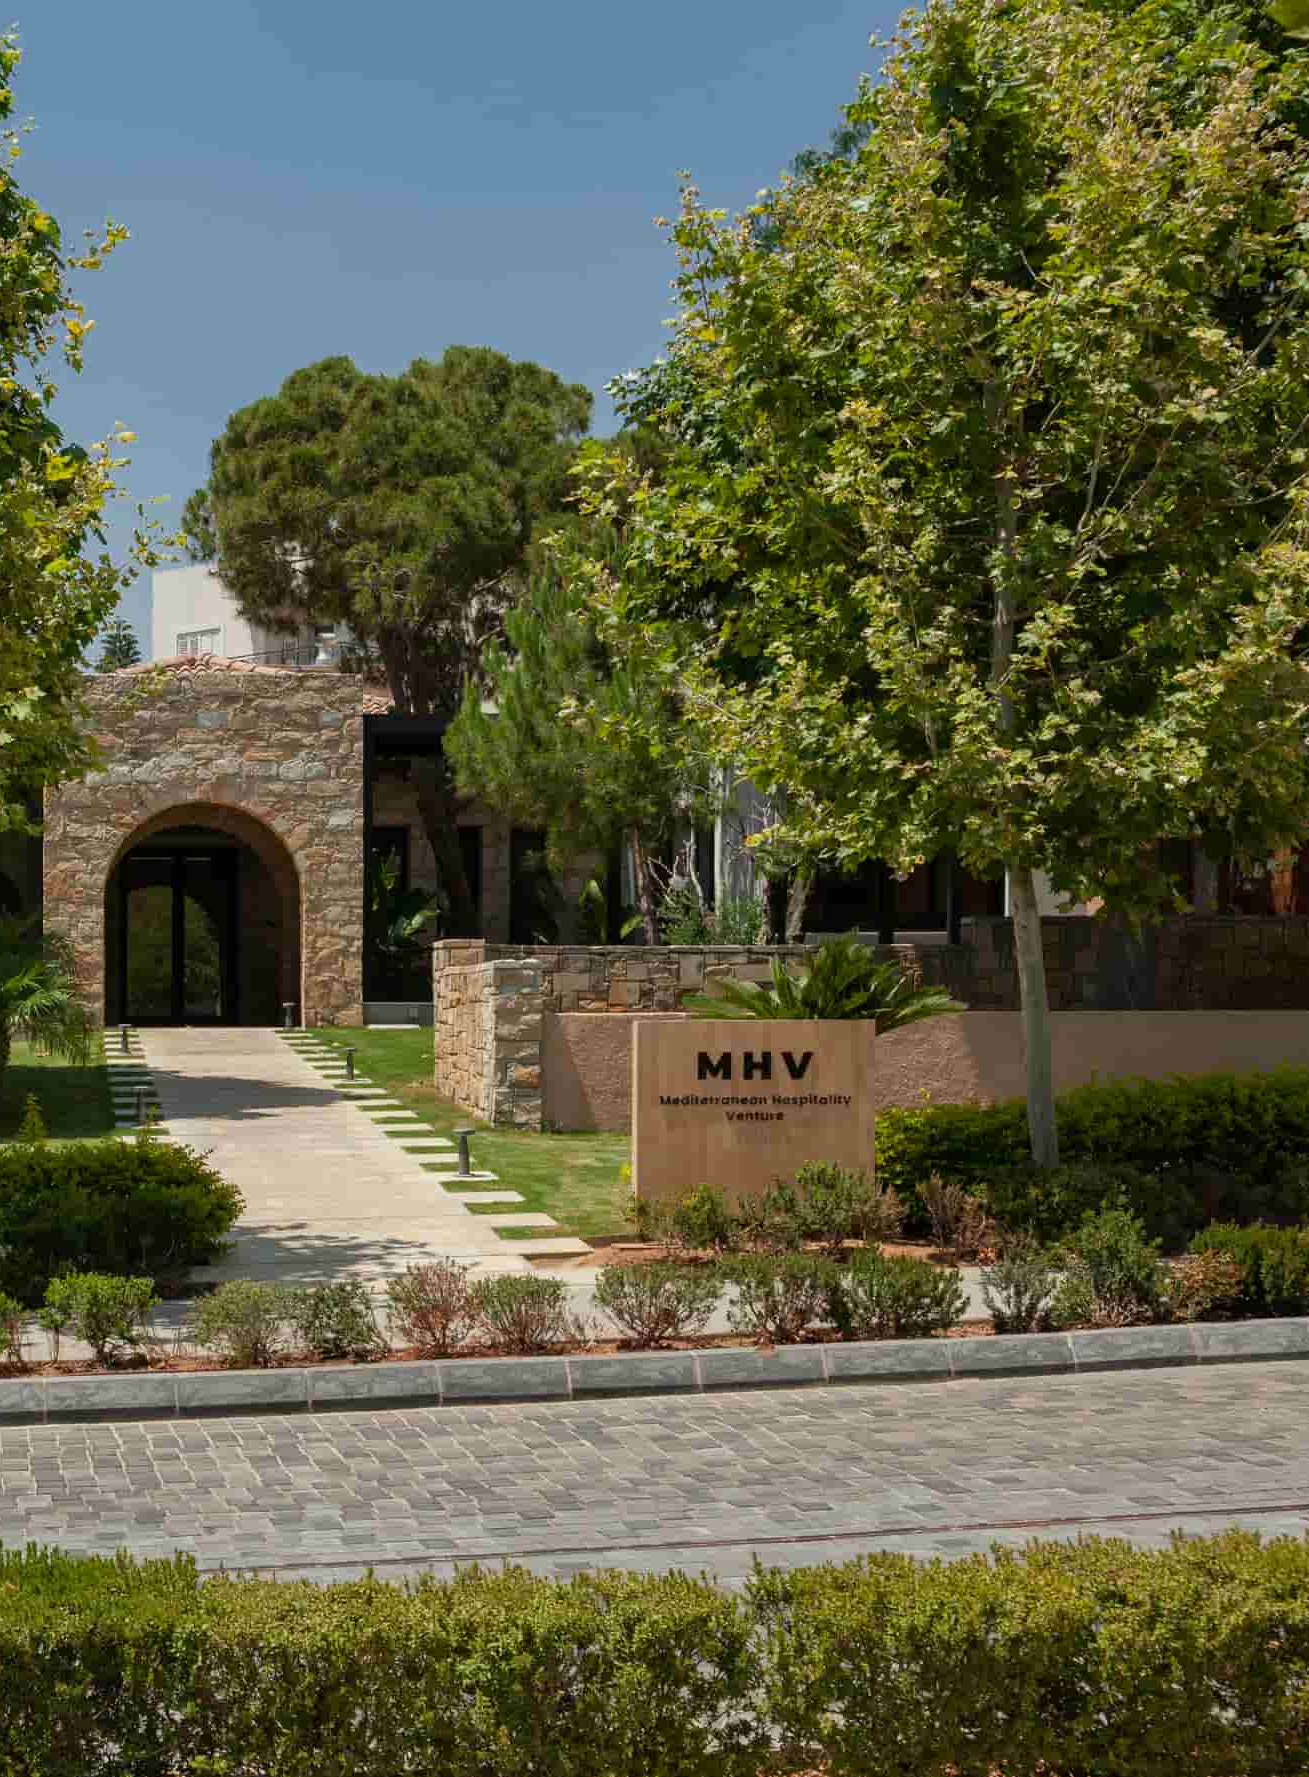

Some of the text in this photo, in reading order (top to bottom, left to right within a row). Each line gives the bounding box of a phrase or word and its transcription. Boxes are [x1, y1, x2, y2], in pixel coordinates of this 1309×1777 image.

[697, 1051, 815, 1080] MHV
[659, 1094, 852, 1108] Mediterranean Hospitality
[725, 1110, 785, 1121] Venture
